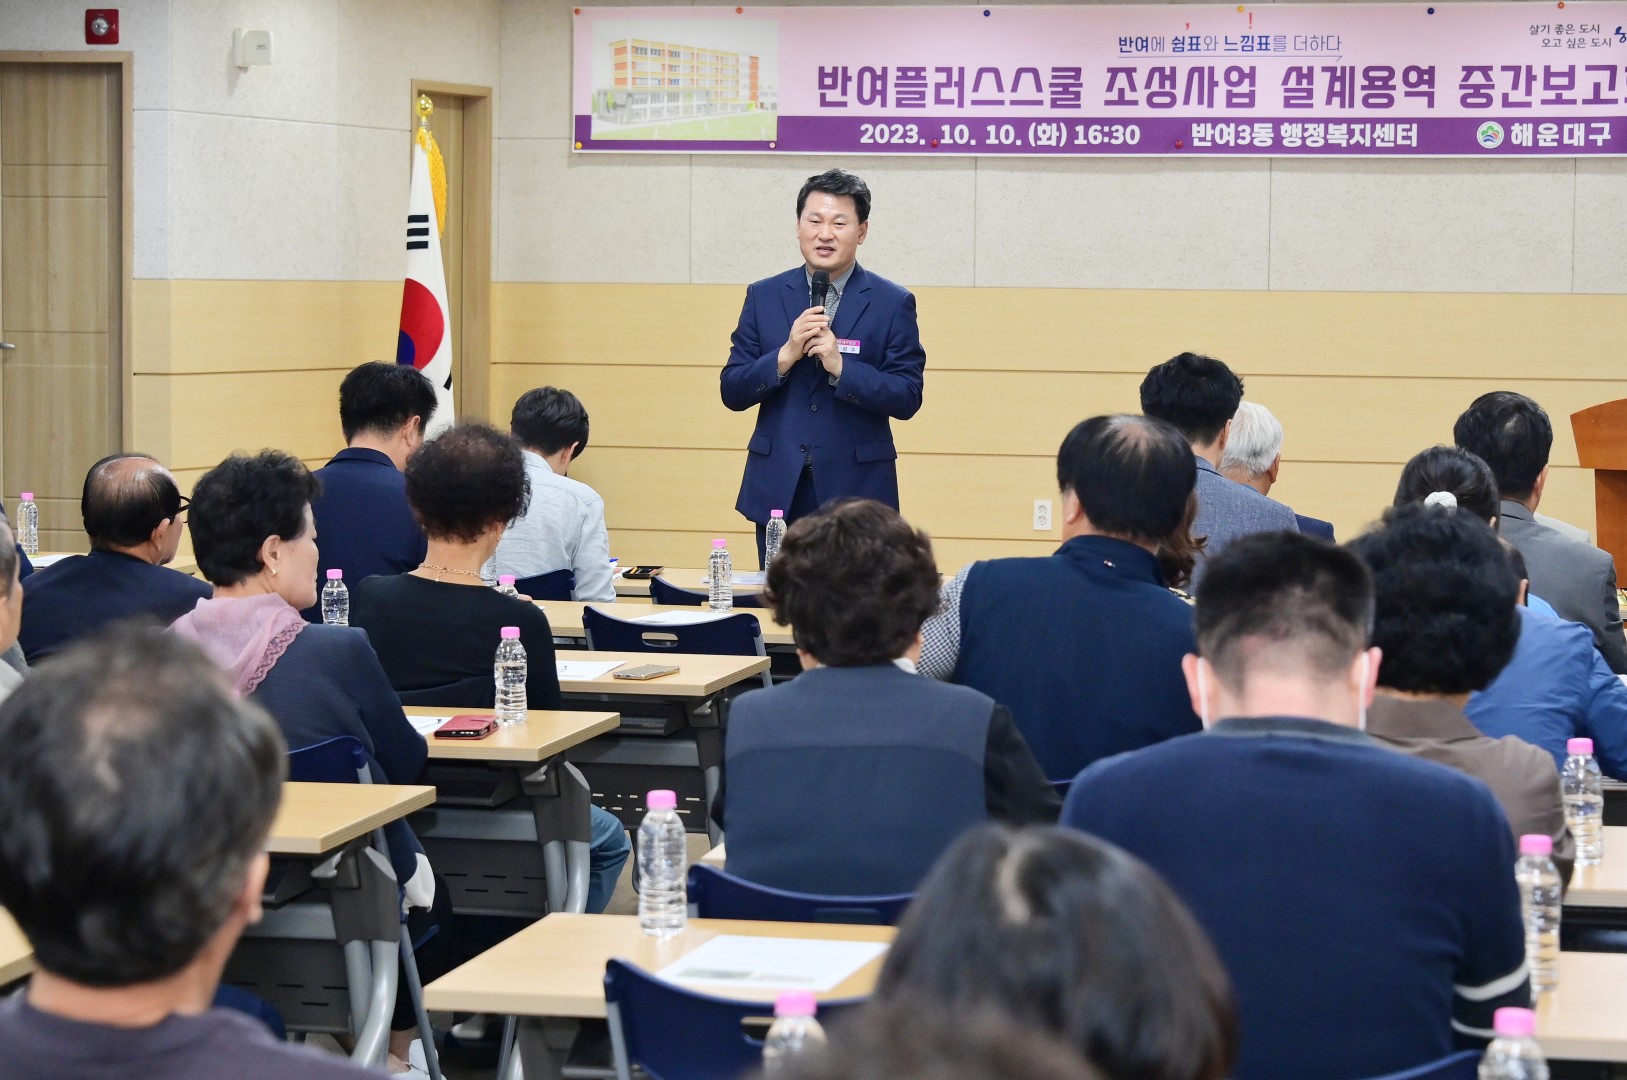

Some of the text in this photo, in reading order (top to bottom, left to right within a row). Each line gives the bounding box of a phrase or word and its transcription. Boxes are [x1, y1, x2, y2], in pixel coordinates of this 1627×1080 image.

[1529, 23, 1600, 36] 살기 좋은 도시
[1118, 35, 1342, 53] 반여에 쉼표와 느낌표를 더하다
[1541, 37, 1612, 49] 오고 싶은 도시
[817, 64, 1627, 109] 반여플러스스쿨 조성사업 설계용역 중간보고
[859, 122, 1141, 148] 2023. 10. 10. (화) 16:30
[1191, 122, 1418, 148] 반여3동 행정복지센터
[1510, 122, 1612, 147] 해운대구
